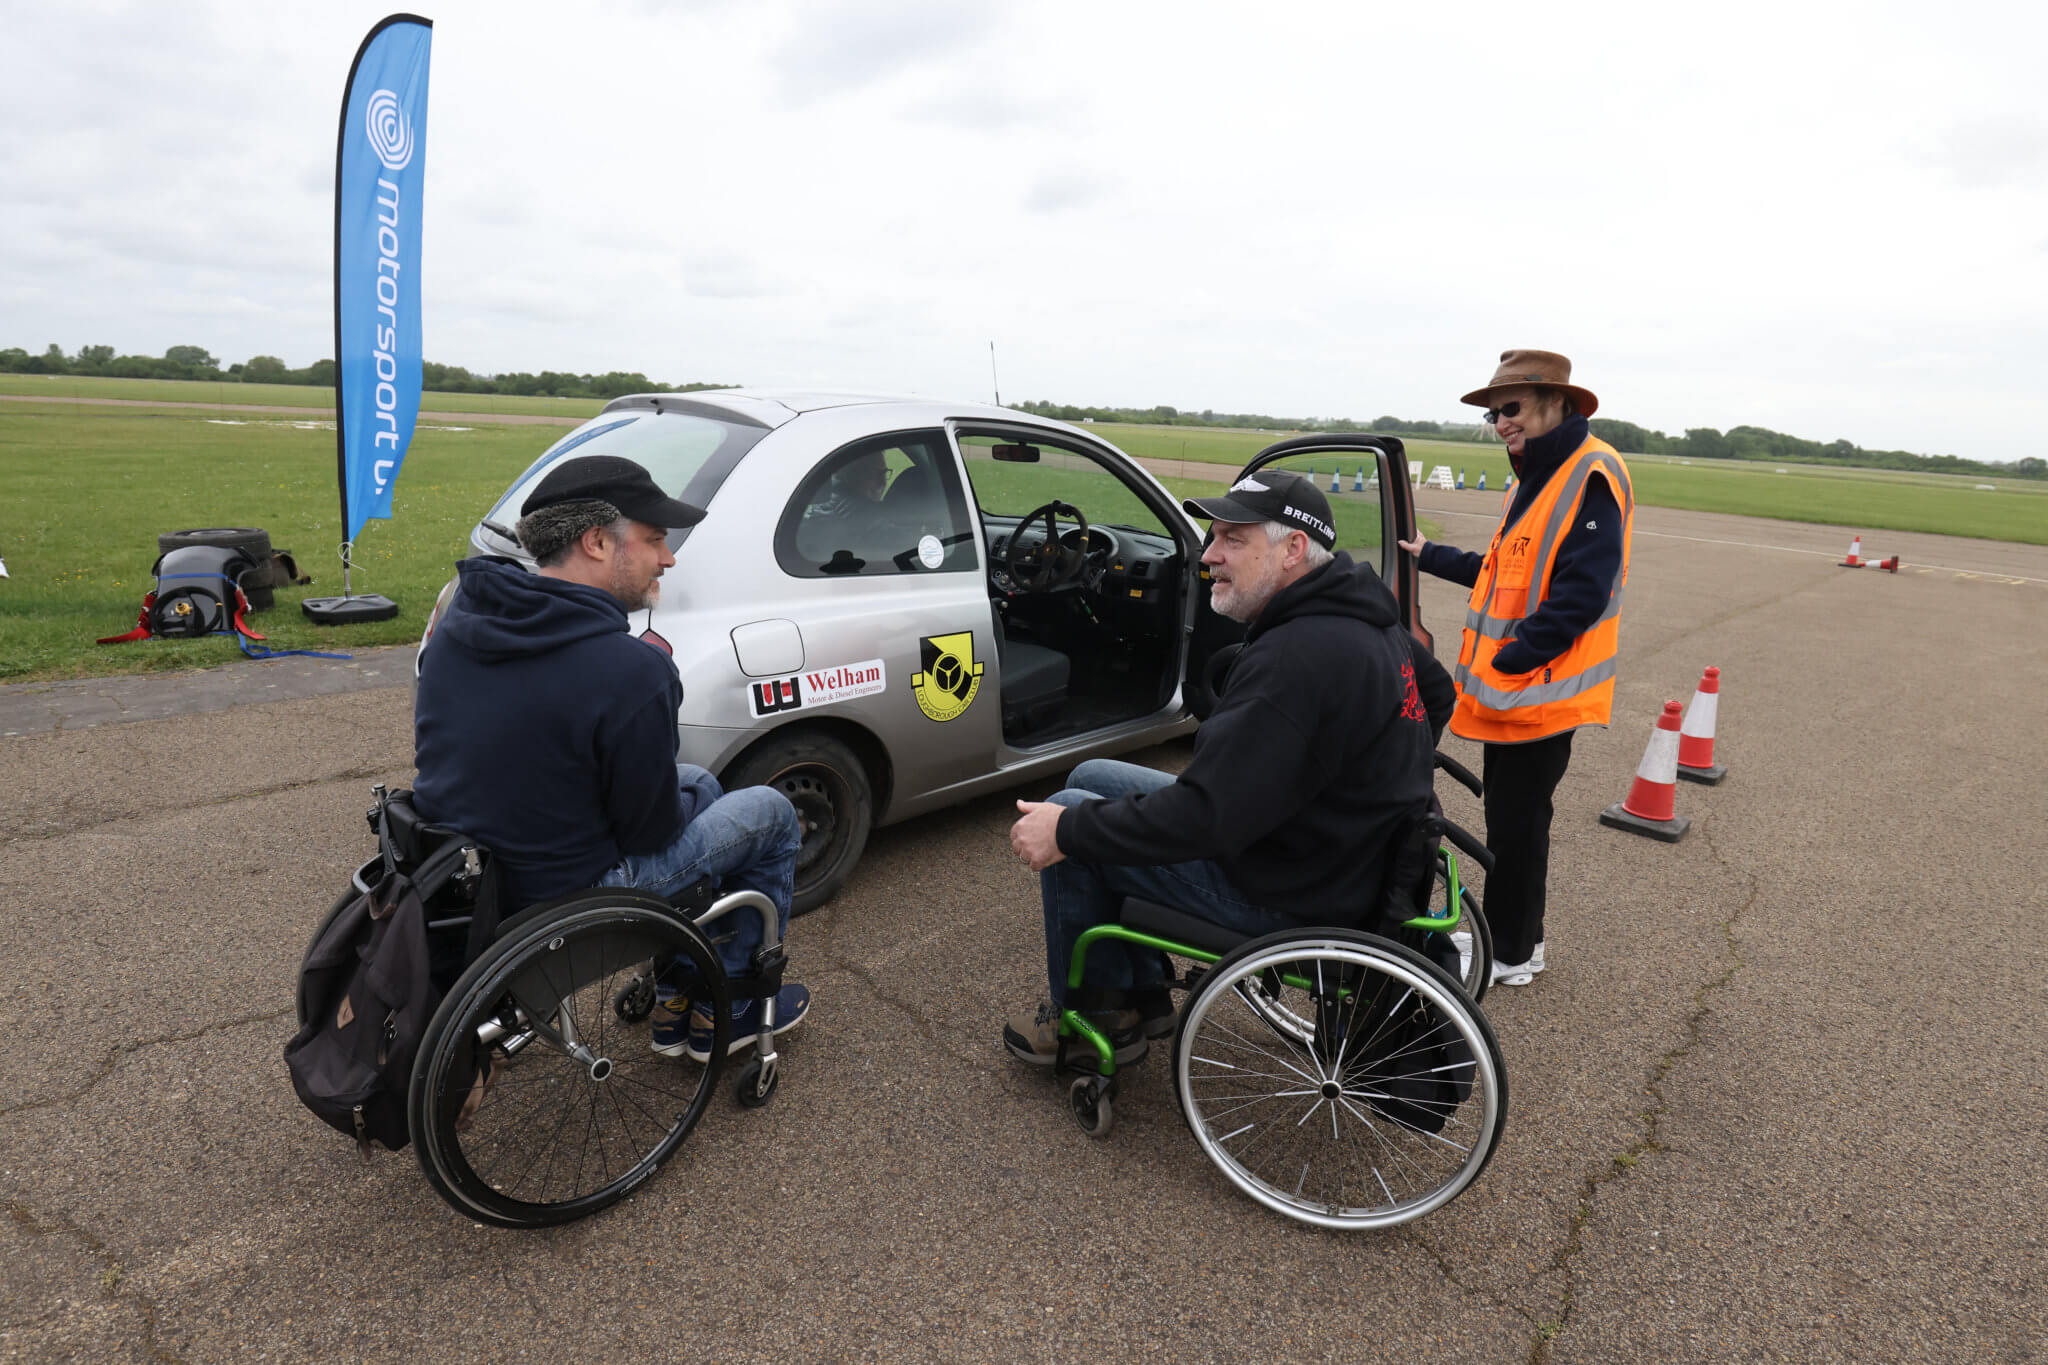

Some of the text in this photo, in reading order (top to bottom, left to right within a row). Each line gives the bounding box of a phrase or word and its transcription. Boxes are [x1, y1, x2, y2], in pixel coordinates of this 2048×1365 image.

[373, 177, 401, 450] motorsport
[1283, 505, 1336, 540] BREITLING
[806, 668, 881, 693] Welham
[808, 695, 828, 704] Motor
